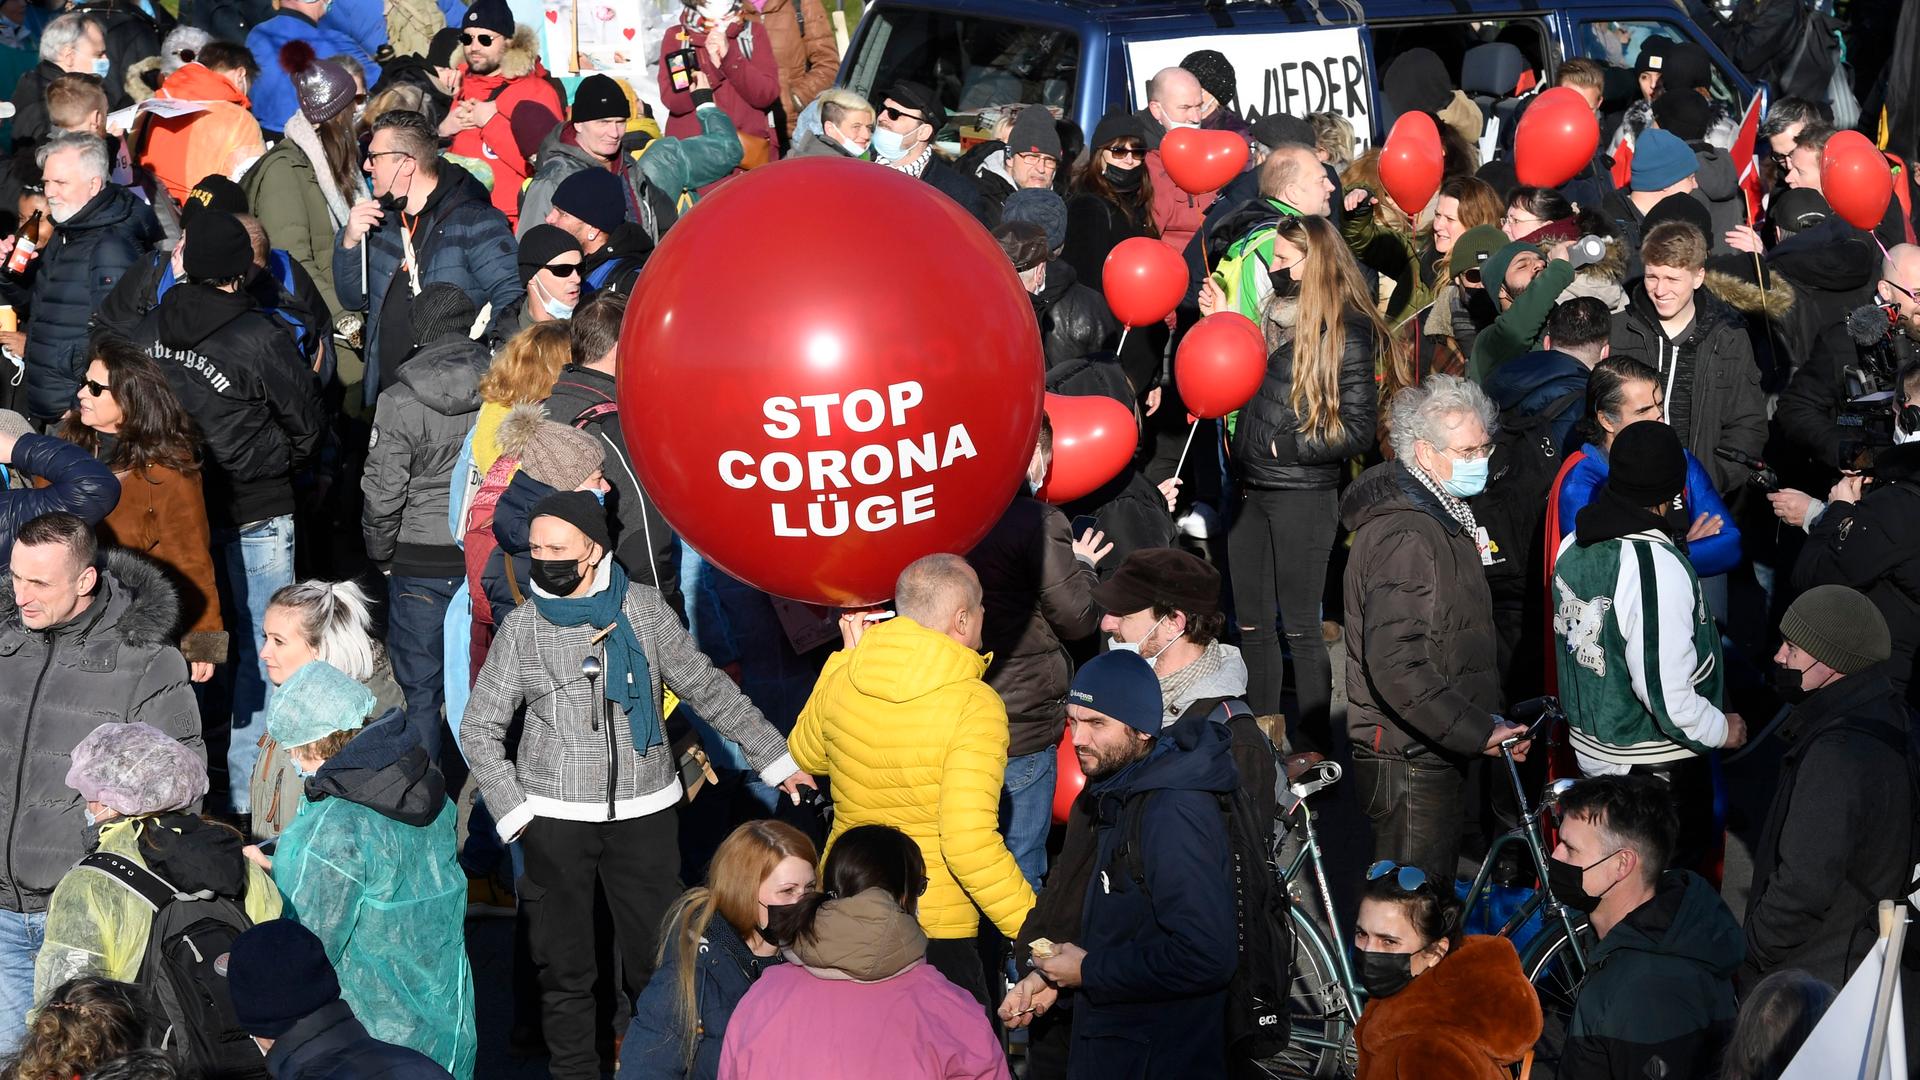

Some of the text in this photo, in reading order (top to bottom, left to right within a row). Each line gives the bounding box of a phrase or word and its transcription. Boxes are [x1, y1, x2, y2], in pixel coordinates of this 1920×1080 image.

[1233, 55, 1366, 121] WIEDER
[144, 339, 231, 392] nbeugsam
[762, 380, 923, 439] STOP
[717, 423, 978, 492] CORONA
[771, 484, 936, 537] LÜGE
[1234, 853, 1244, 952] PROTECTOR
[1317, 872, 1333, 912] SPARTA
